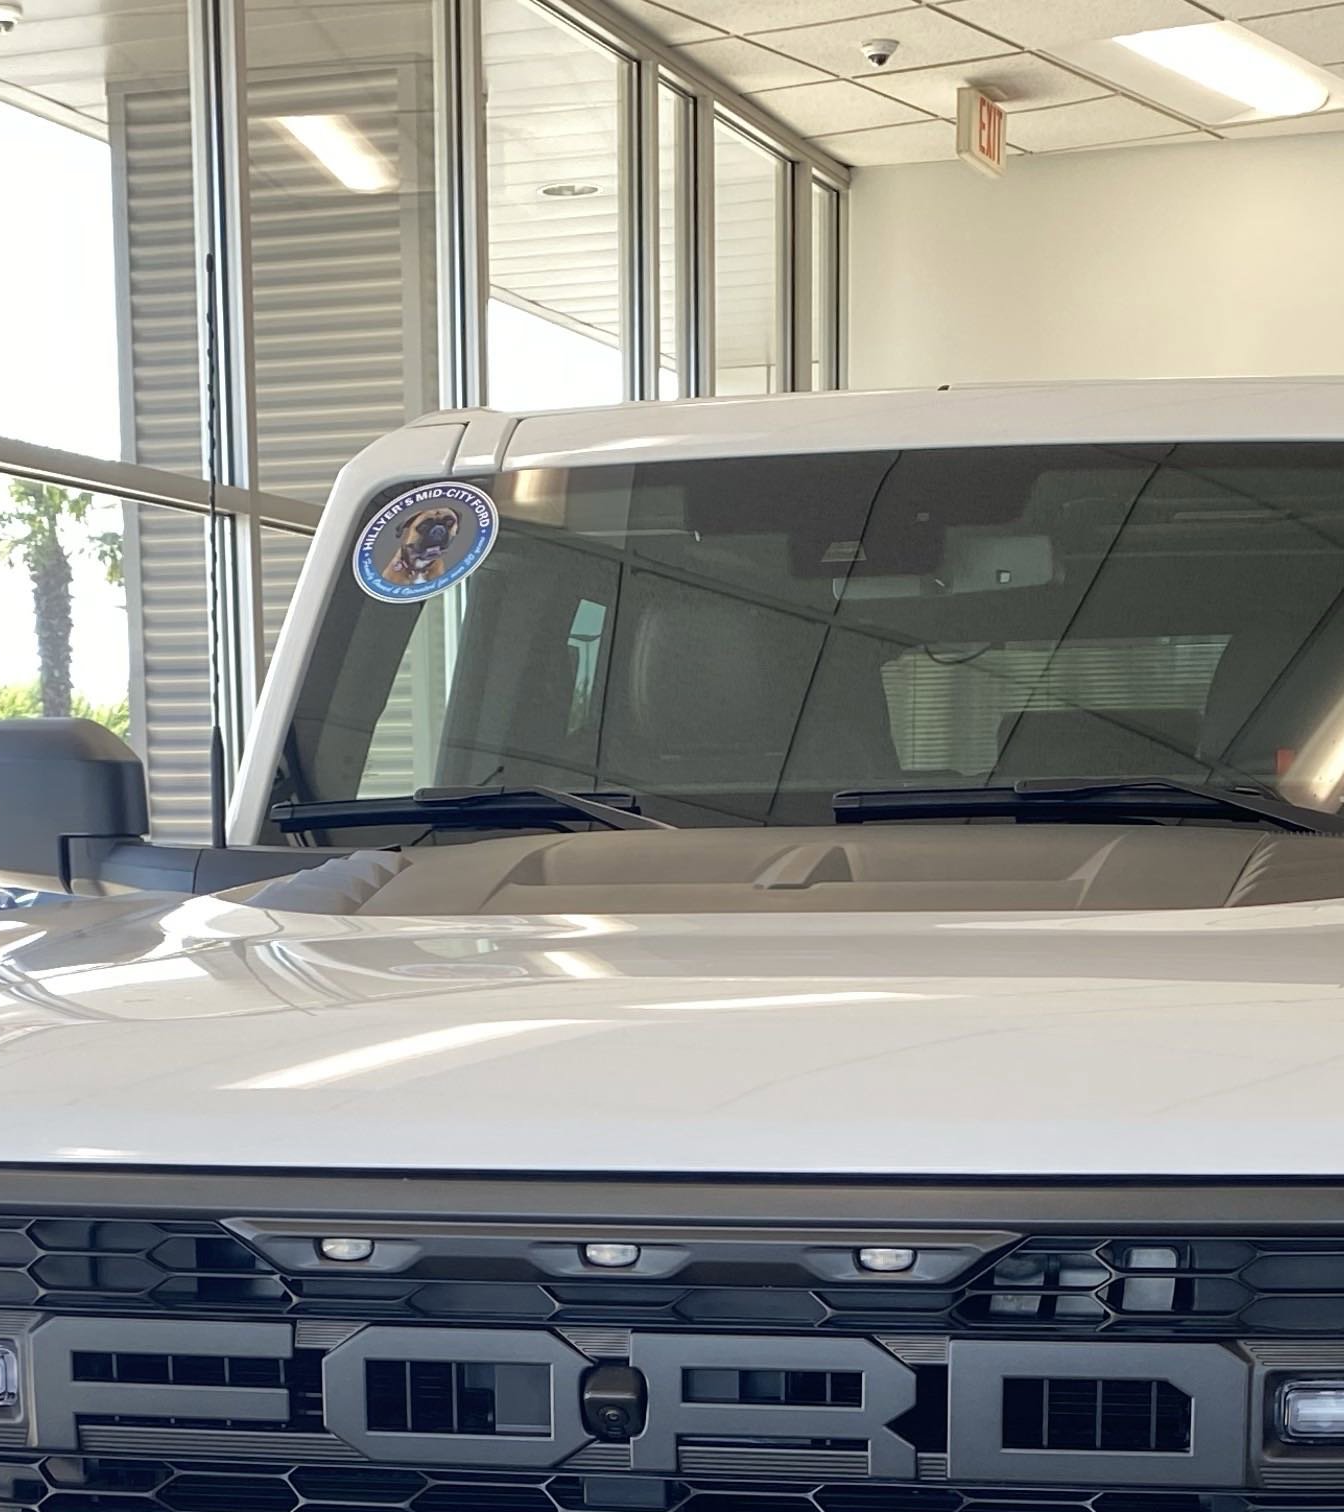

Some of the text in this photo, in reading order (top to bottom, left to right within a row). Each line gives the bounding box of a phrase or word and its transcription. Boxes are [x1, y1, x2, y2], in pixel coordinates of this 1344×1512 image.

[362, 488, 490, 551] HILLYER'S MID-CITY FORD
[38, 1317, 1253, 1484] FORD
